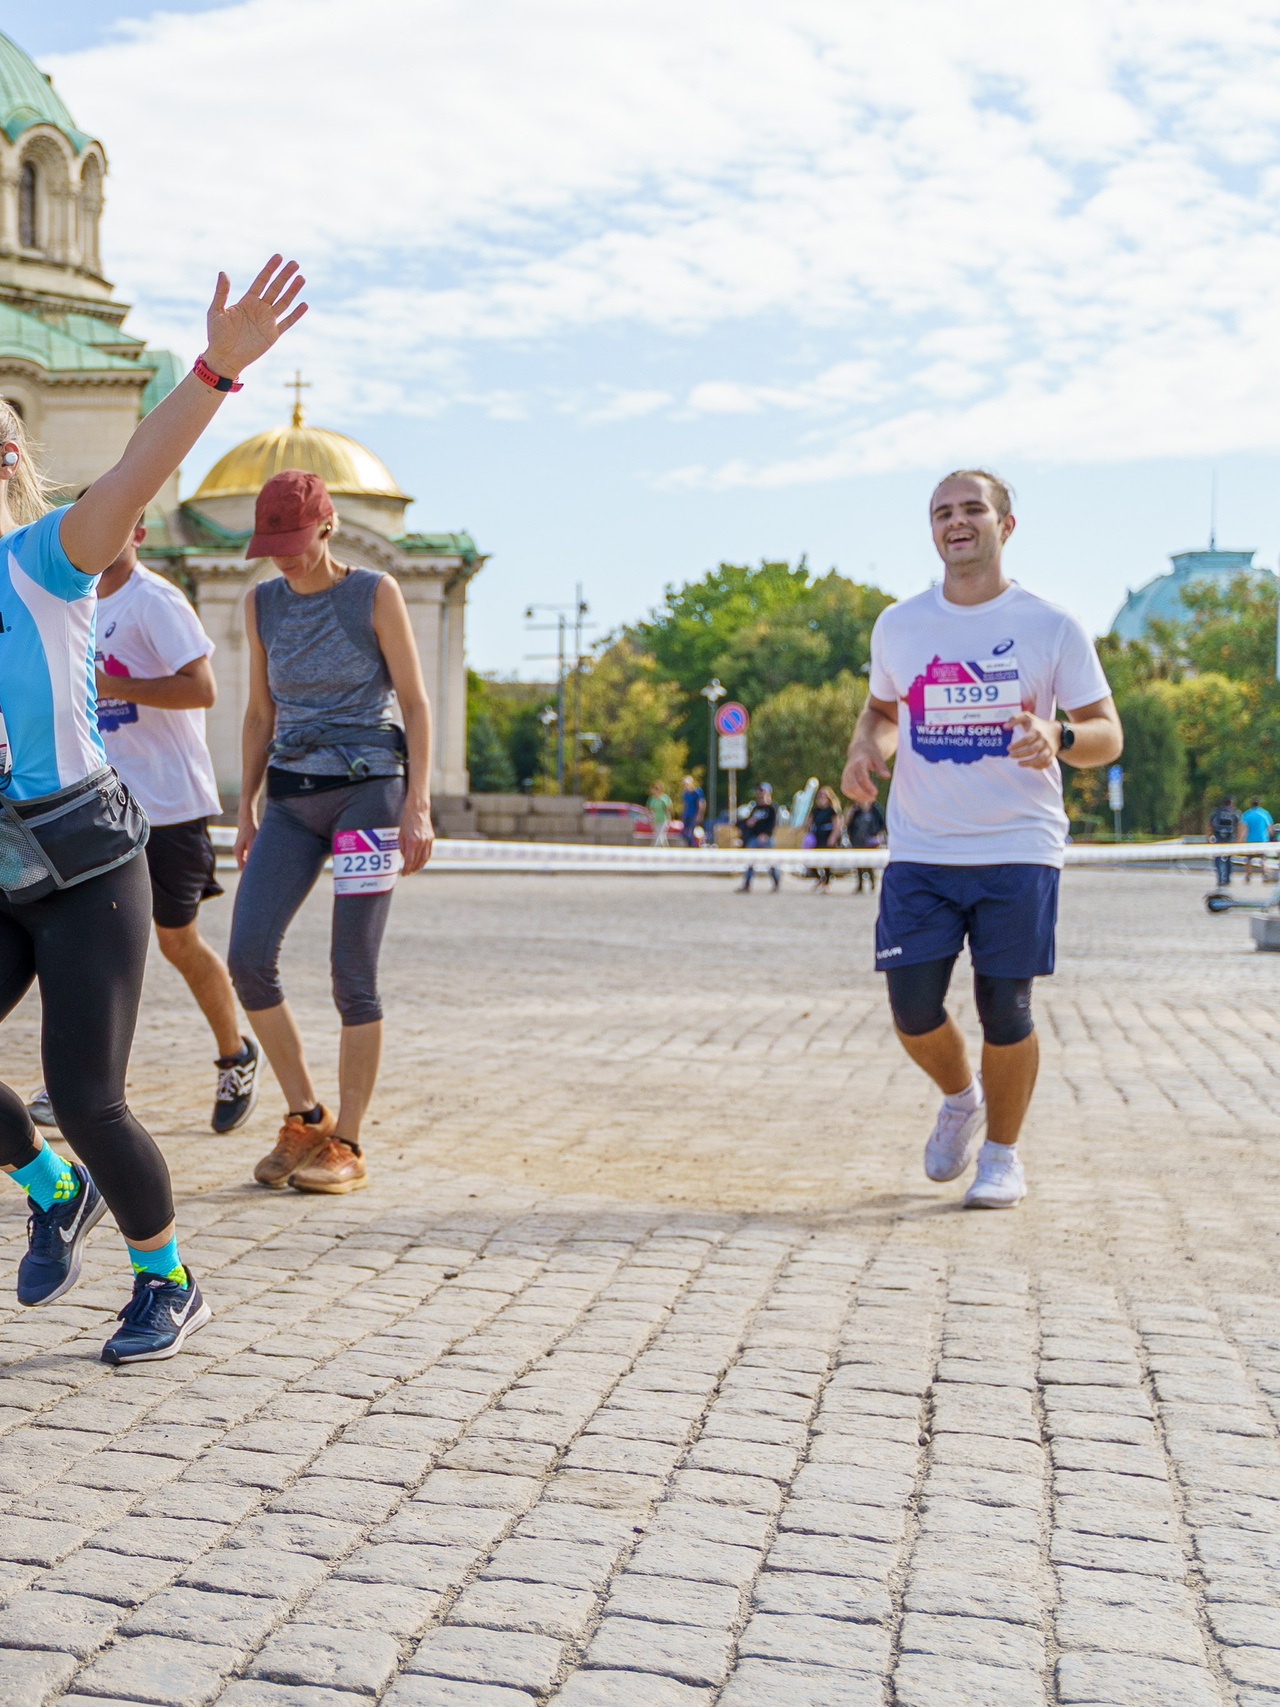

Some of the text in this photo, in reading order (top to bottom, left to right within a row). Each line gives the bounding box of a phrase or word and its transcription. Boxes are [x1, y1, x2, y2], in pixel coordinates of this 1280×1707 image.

[944, 685, 999, 704] 1399
[946, 725, 966, 736] AIR
[967, 725, 1003, 736] SOFIA
[917, 736, 974, 747] MARATHON
[344, 853, 392, 873] 2295
